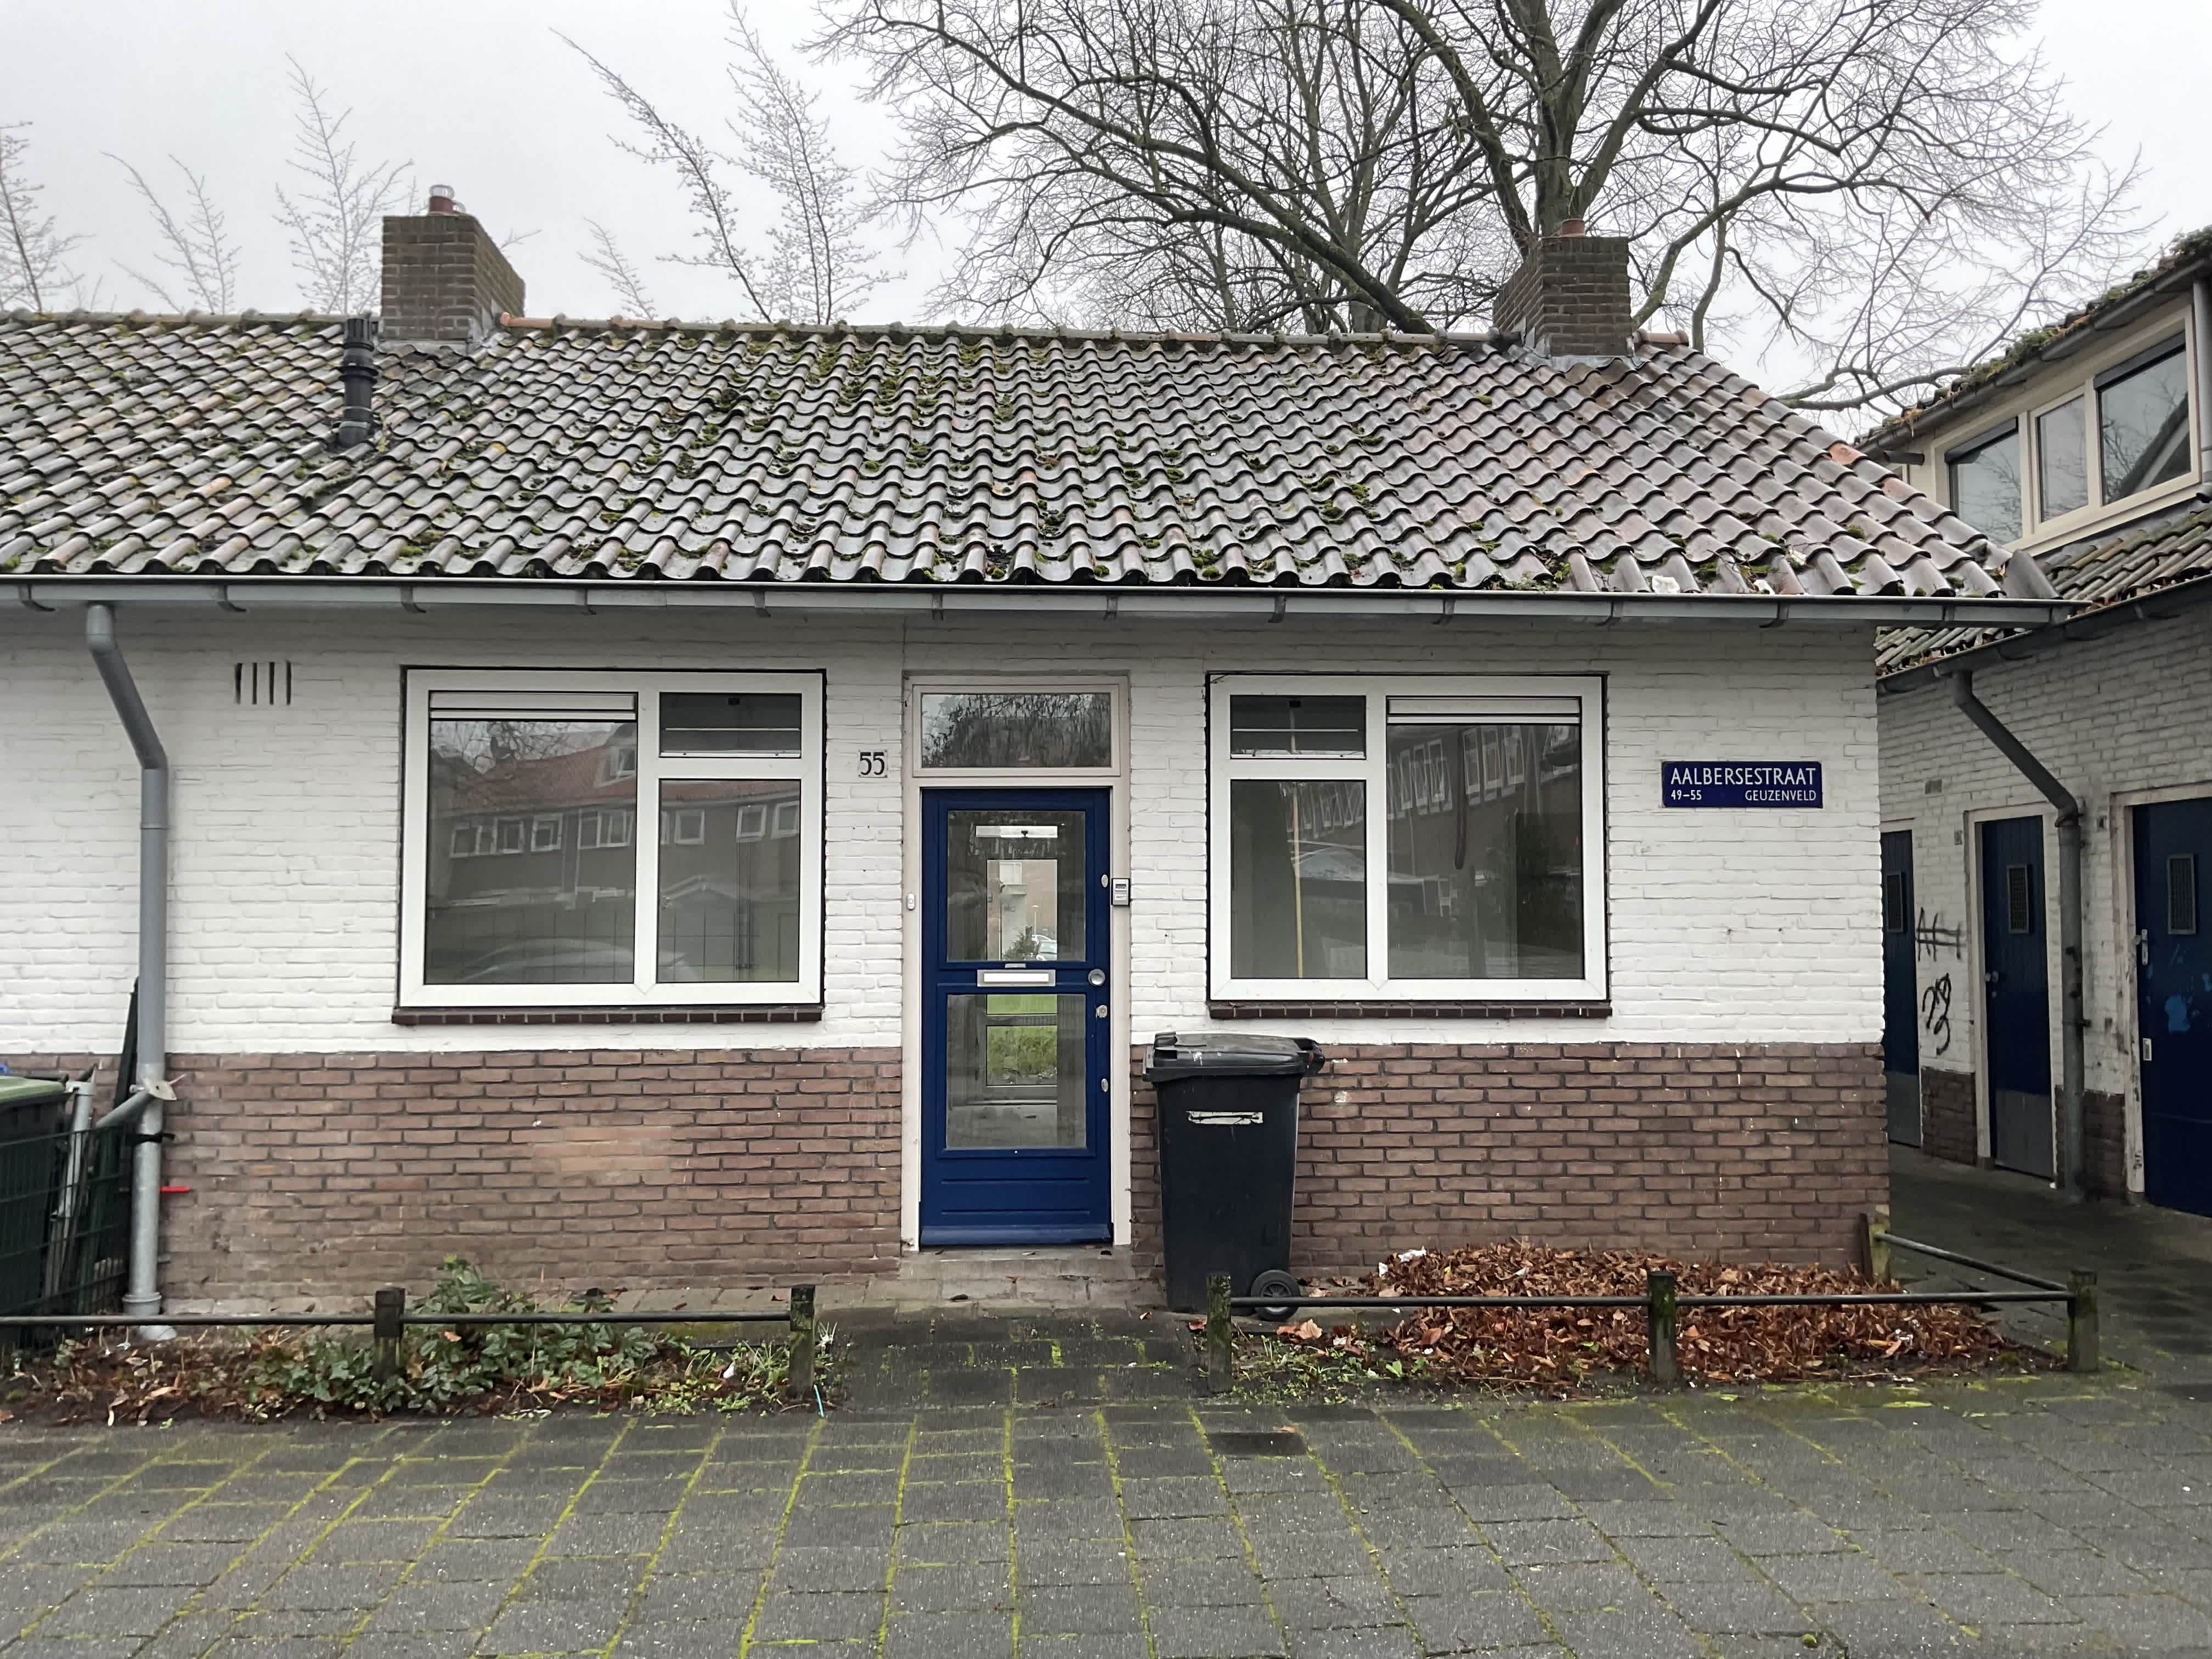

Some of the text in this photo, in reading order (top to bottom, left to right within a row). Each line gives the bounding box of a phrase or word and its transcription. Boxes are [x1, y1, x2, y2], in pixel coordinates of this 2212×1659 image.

[860, 752, 885, 776] 55
[1671, 768, 1816, 785] AALBERSESTRAAT
[1671, 789, 1816, 801] 49-55 GEUZENVELD
